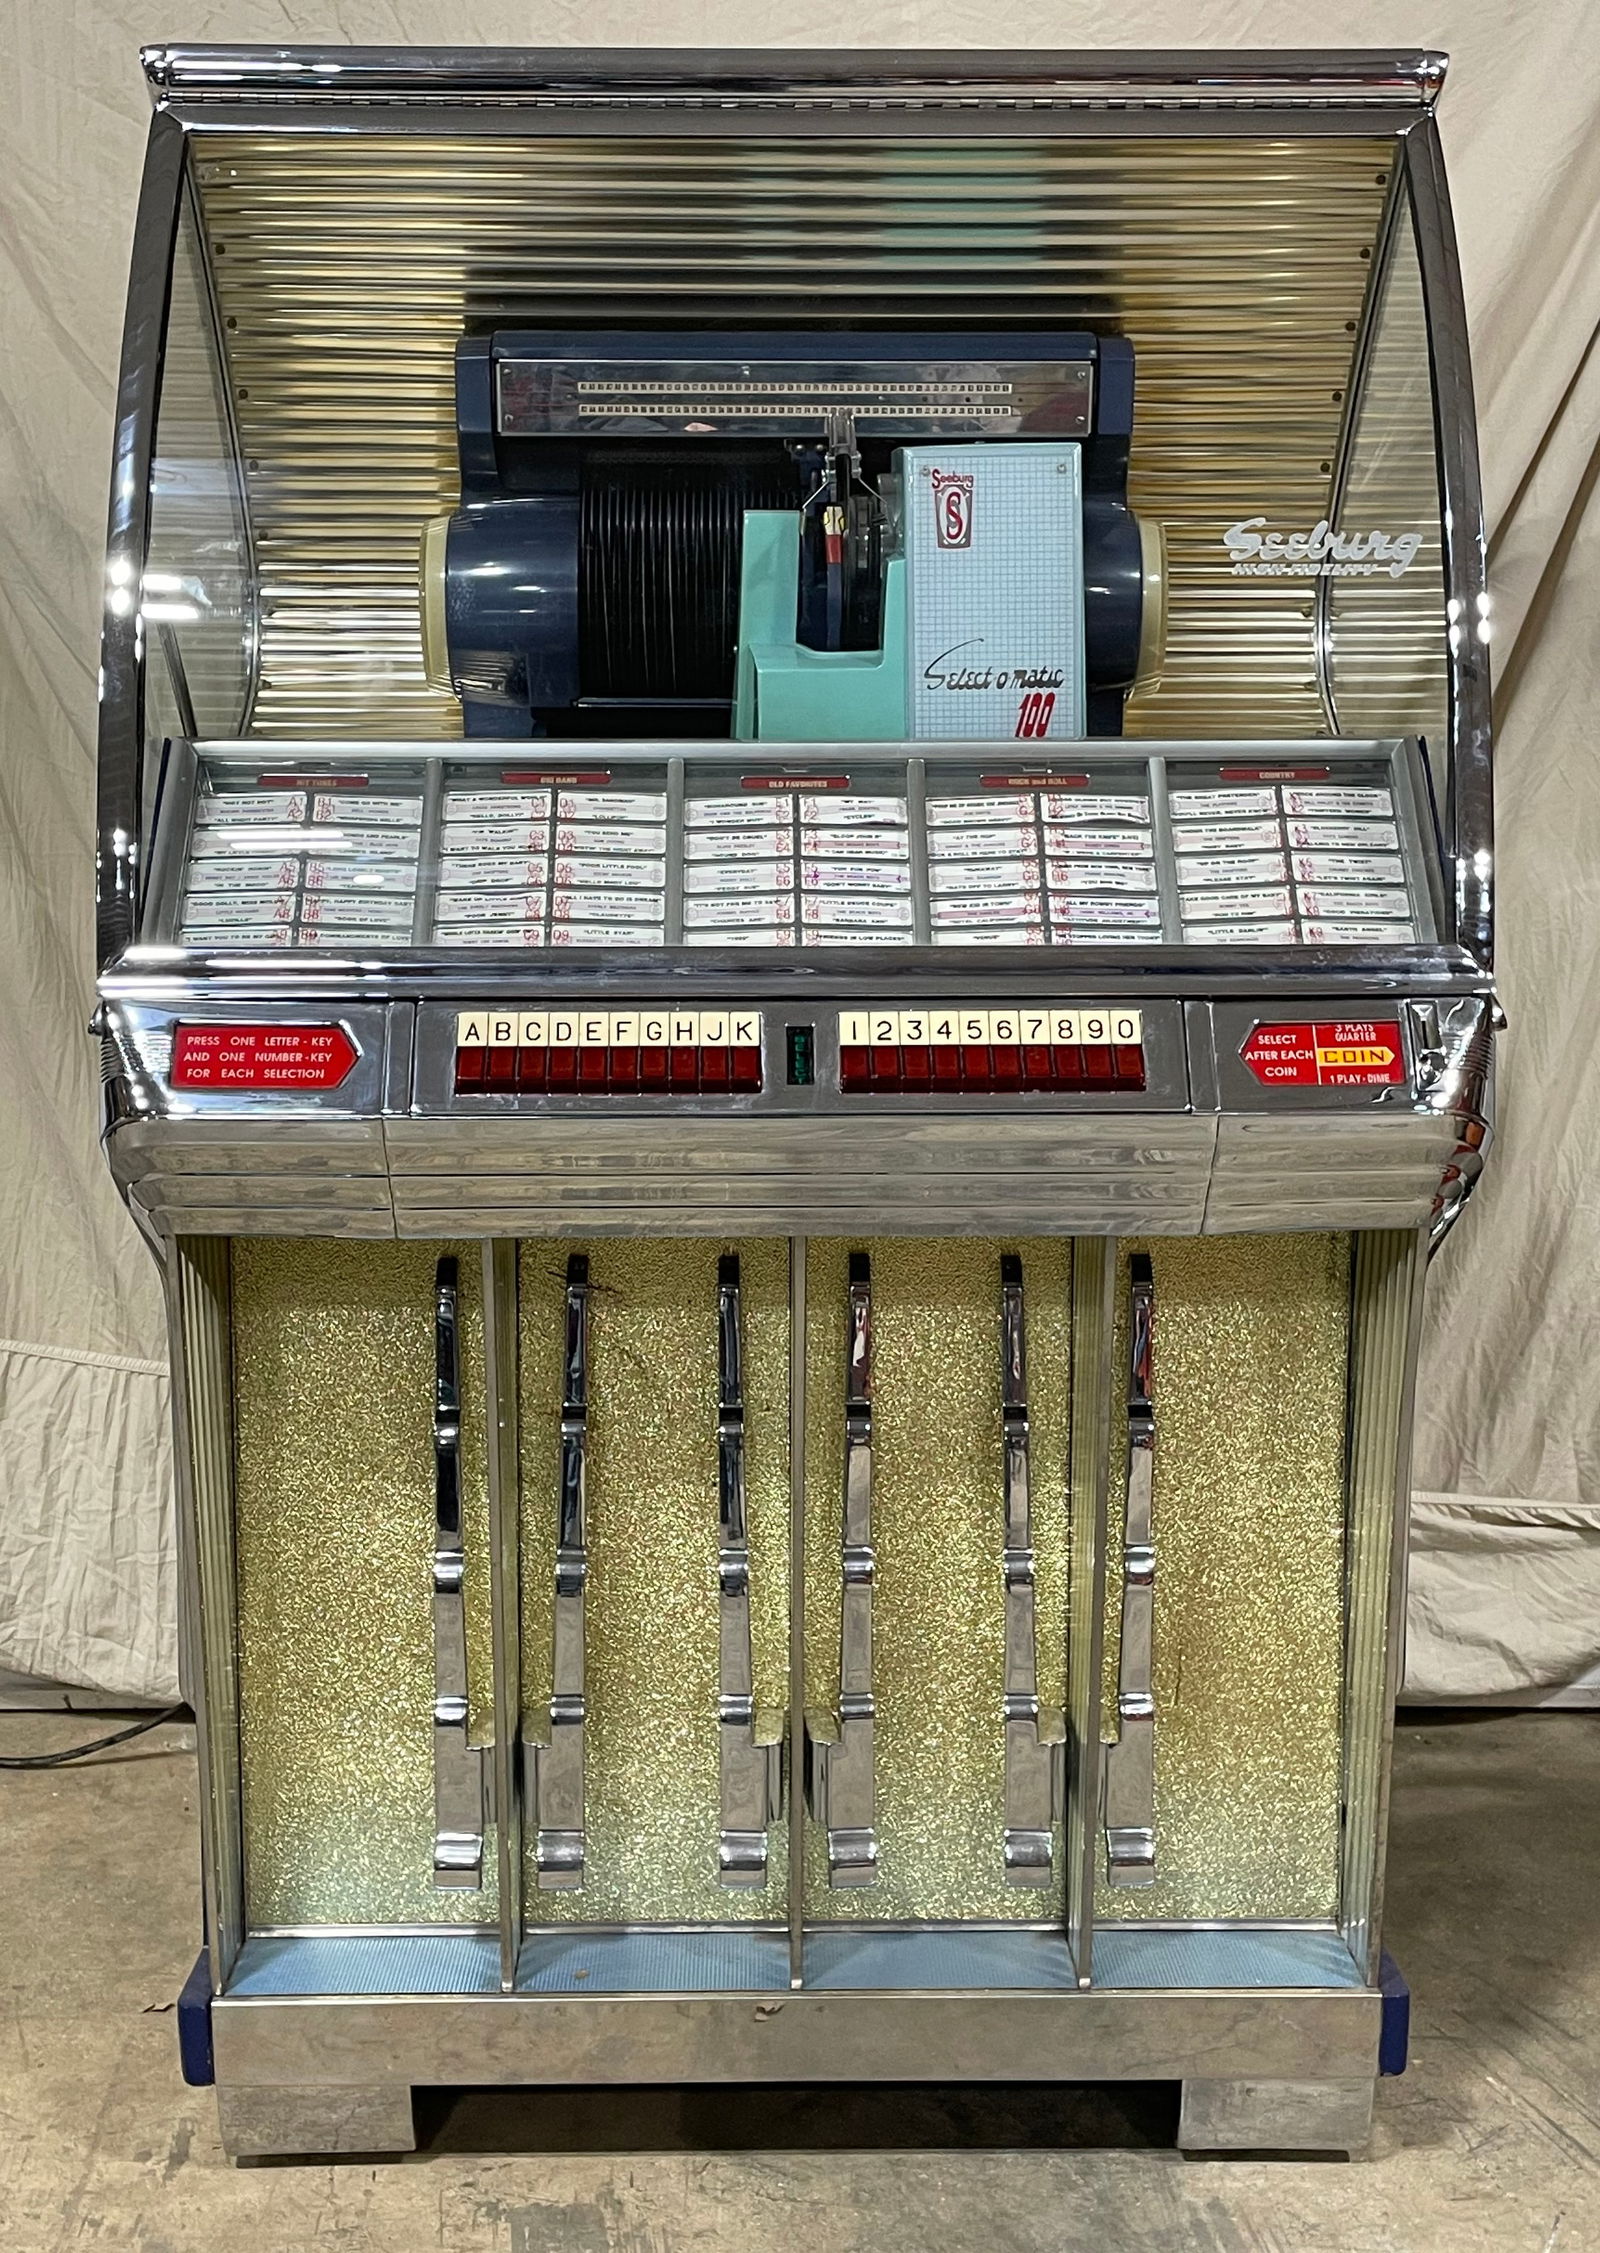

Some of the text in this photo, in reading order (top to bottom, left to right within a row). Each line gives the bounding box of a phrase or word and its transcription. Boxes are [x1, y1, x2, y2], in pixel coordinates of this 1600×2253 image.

[932, 469, 974, 488] Seeburg
[1223, 517, 1423, 578] Seeburg
[1015, 692, 1056, 738] 100
[768, 780, 784, 788] OLD
[464, 1021, 753, 1041] A B C D E F G H J K
[877, 1020, 892, 1041] 2
[907, 1020, 922, 1041] 3
[937, 1020, 952, 1041] 4
[967, 1020, 982, 1041] 5
[997, 1020, 1013, 1041] 6
[1027, 1020, 1043, 1041] 7
[1058, 1020, 1073, 1041] 8
[1088, 1020, 1103, 1041] 9
[1118, 1020, 1134, 1041] 0
[1344, 1023, 1374, 1032] PLAYS
[187, 1036, 220, 1046] PRESS
[230, 1036, 256, 1046] ONE
[1258, 1034, 1297, 1045] SELECT
[1334, 1032, 1377, 1042] QUARTER
[183, 1052, 210, 1062] AND
[219, 1052, 245, 1062] ONE
[1244, 1050, 1314, 1061] AFTER EACH
[1324, 1050, 1385, 1063] COIN
[187, 1068, 325, 1079] FOR EACH SELECTION
[1264, 1066, 1297, 1077] COIN
